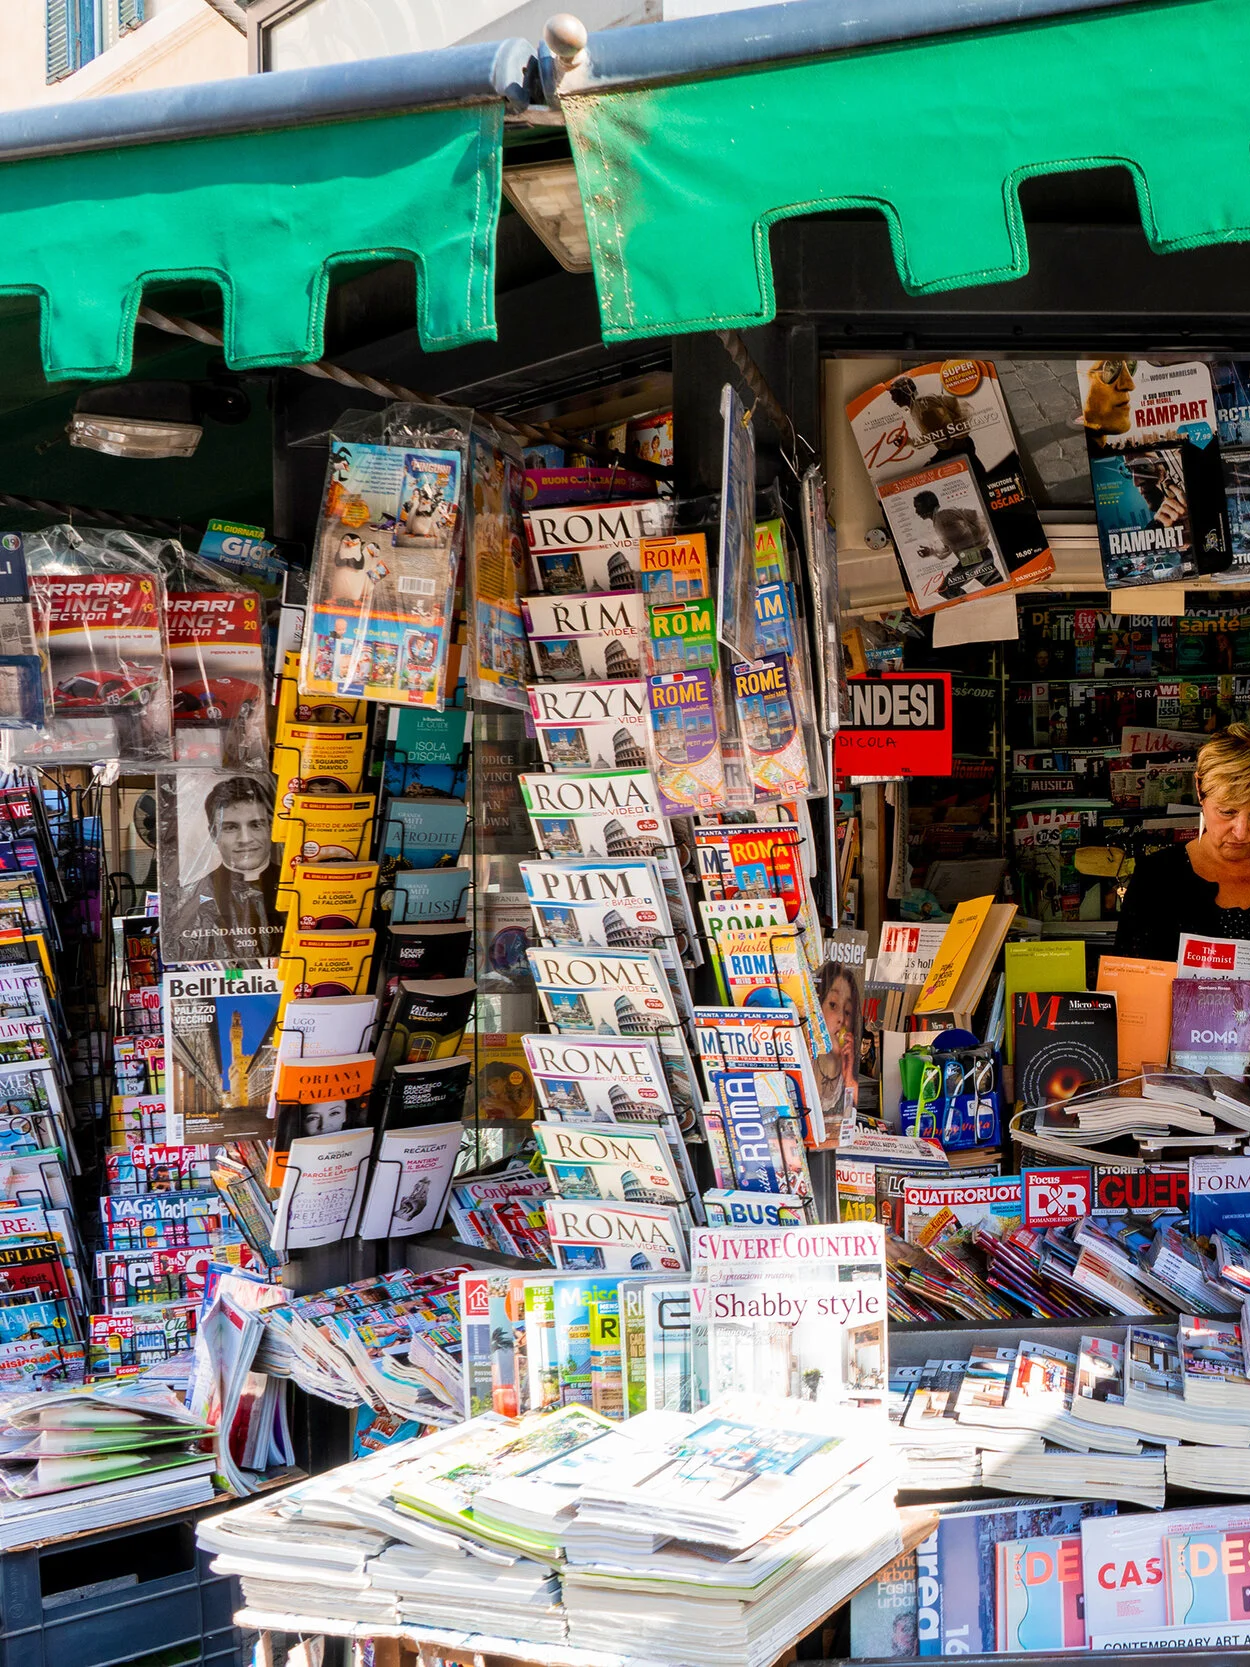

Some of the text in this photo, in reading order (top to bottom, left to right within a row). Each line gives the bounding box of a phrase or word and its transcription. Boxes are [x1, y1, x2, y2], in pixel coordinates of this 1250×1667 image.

[942, 361, 973, 378] SUPER
[1170, 368, 1197, 379] HARRELSON
[1135, 399, 1208, 428] RAMPART
[541, 476, 569, 486] BUON
[212, 523, 264, 539] LA GIORNATA
[1109, 526, 1184, 554] RAMPART
[644, 548, 700, 568] ROMA
[243, 620, 257, 630] 20
[552, 601, 634, 634] ŘÍM
[653, 610, 711, 638] ROM
[1179, 616, 1240, 633] santé
[736, 667, 786, 698] ROME
[652, 681, 709, 708] ROME
[416, 741, 446, 751] ISOLA
[1031, 778, 1074, 791] MUSICA
[532, 779, 649, 812] ROMA
[608, 807, 644, 815] VIDEO
[392, 831, 458, 843] AFRODITE
[731, 838, 789, 862] ROMA
[539, 871, 634, 901] РИМ
[182, 927, 253, 939] CALENDARIO
[236, 938, 258, 948] 2020
[1187, 952, 1232, 963] Economist
[1203, 946, 1217, 956] The
[542, 960, 655, 988] ROME
[169, 977, 278, 998] Bell'Italia
[173, 1005, 216, 1016] PALAZZO
[1069, 1000, 1112, 1009] MicroMega
[173, 1015, 214, 1025] VECCHIO
[1191, 1030, 1238, 1044] ROMA
[764, 1042, 794, 1056] BUS
[538, 1046, 650, 1076] ROME
[300, 1070, 362, 1084] ORIANA
[298, 1084, 363, 1099] FALLACI
[725, 1077, 771, 1162] ROMA
[403, 1144, 448, 1154] RECALCATI
[556, 1132, 643, 1164] ROM
[318, 1151, 353, 1161] GARDINI
[1099, 1166, 1137, 1175] STORIE
[1029, 1175, 1060, 1184] Focus
[1029, 1185, 1087, 1218] D&R
[730, 1202, 778, 1226] BUS
[845, 1201, 876, 1222] A112
[563, 1210, 669, 1246] ROMA
[714, 1291, 879, 1326] Shabby style
[1215, 1635, 1240, 1647] ART
